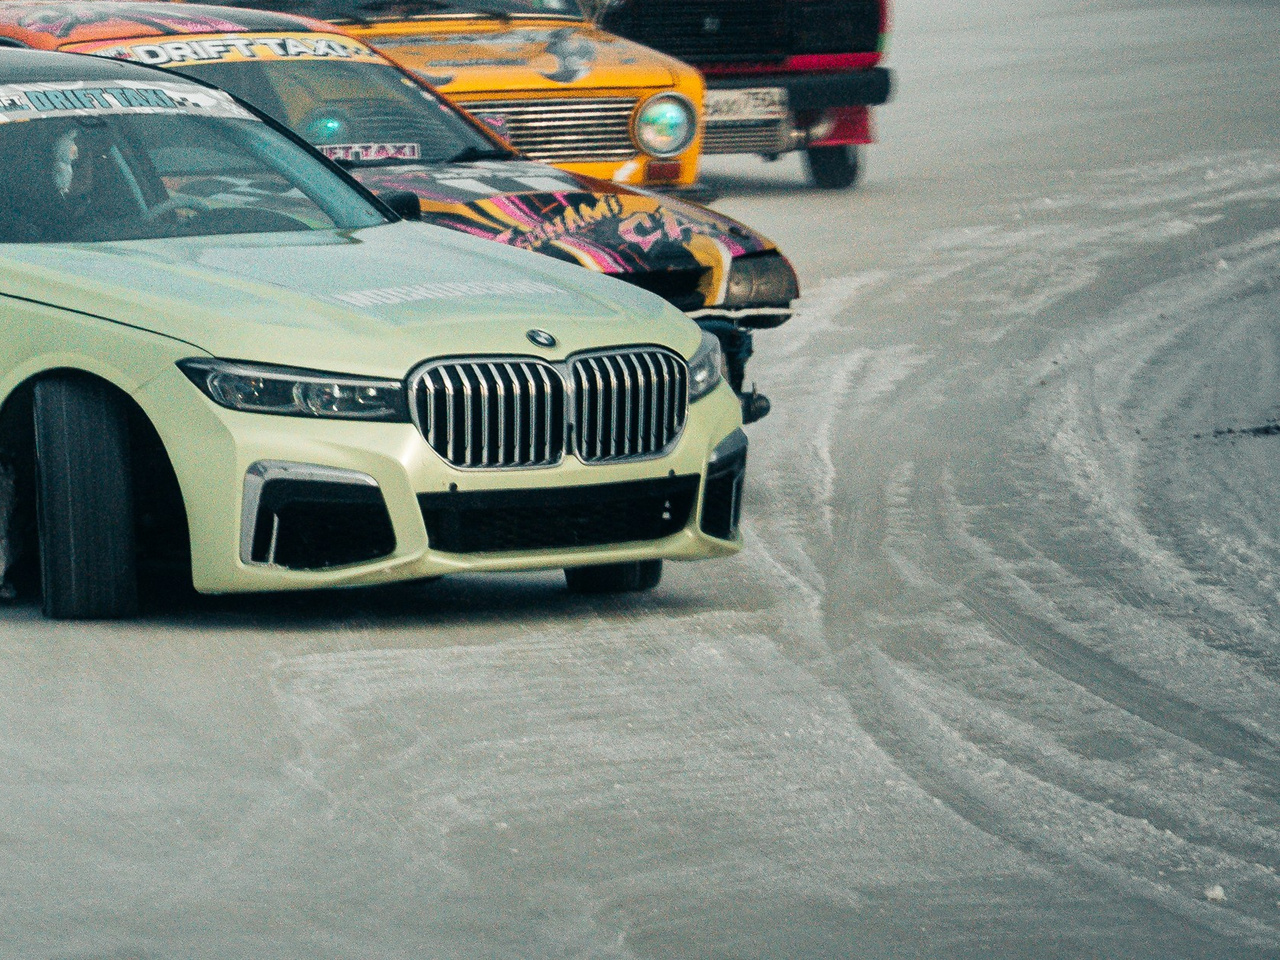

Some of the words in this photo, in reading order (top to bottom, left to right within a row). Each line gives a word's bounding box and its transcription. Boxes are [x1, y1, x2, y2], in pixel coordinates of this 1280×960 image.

[130, 37, 260, 65] DRIFT
[253, 36, 351, 58] TAXI
[23, 88, 114, 111] DRIFT
[108, 88, 178, 108] TAXI
[359, 144, 416, 159] TAXI
